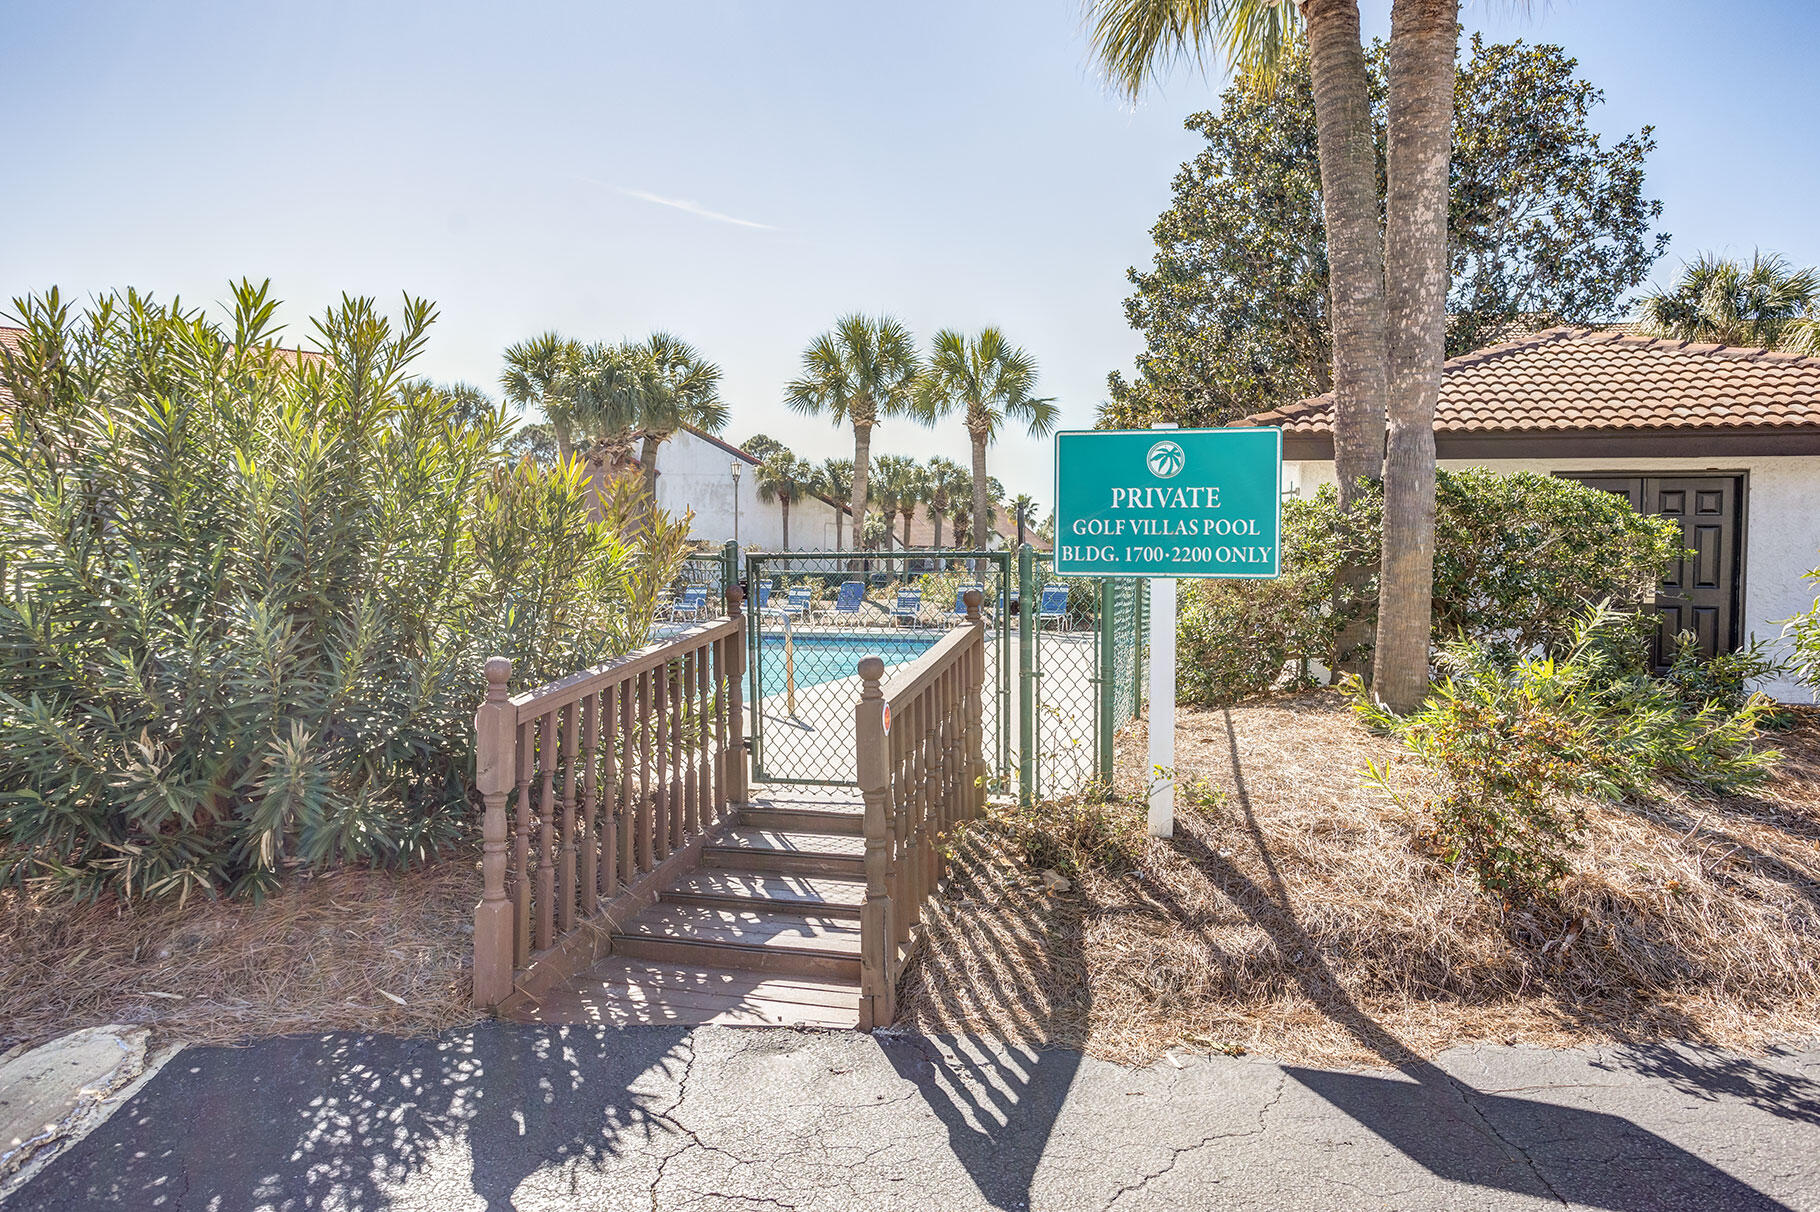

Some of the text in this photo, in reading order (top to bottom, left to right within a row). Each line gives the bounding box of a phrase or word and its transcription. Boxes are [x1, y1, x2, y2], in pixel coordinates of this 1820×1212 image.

[1110, 486, 1222, 509] PRIVATE
[1072, 518, 1261, 536] GOLF VILLAS POOL
[1061, 545, 1120, 562] BLDG.
[1215, 546, 1273, 564] ONLY
